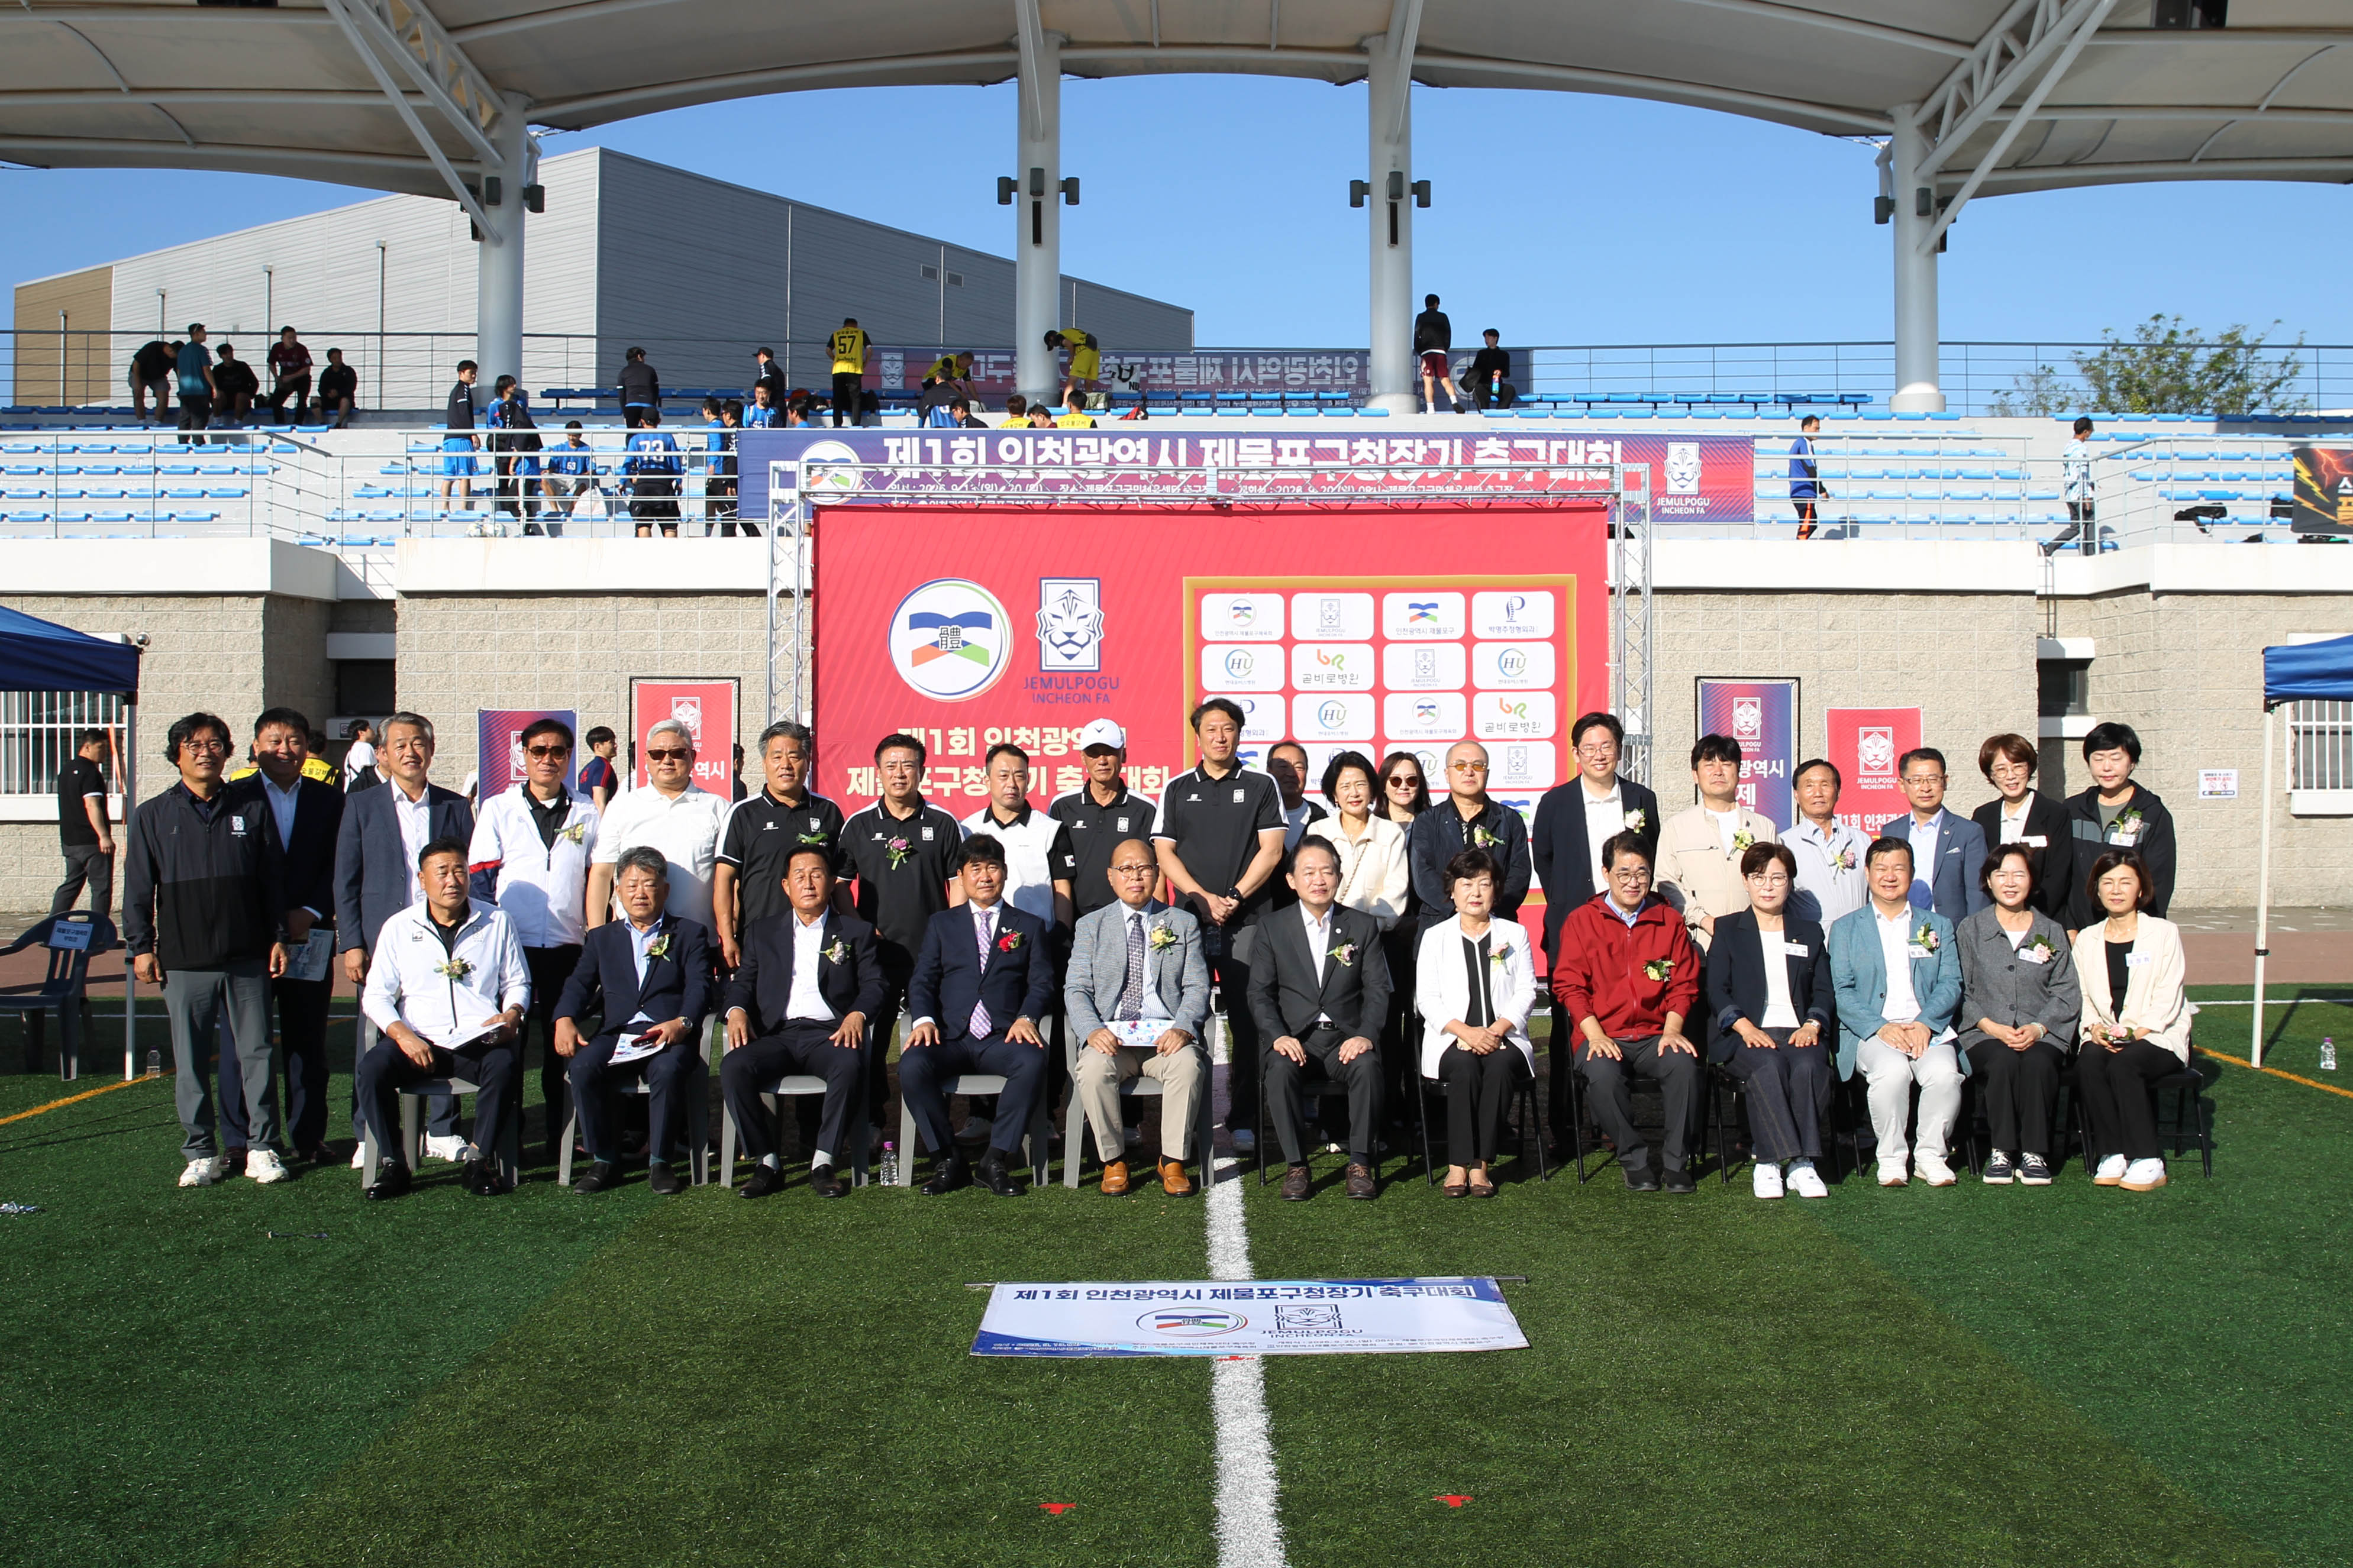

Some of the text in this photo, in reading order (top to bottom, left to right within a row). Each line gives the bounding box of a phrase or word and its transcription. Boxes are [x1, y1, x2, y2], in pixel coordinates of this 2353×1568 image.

[838, 335, 856, 354] 57
[638, 439, 664, 463] 73
[883, 436, 1622, 481] 제1회 인천광역시 제물포구청장기 축구대회
[1657, 497, 1710, 506] JEMULPOGU
[1230, 658, 1255, 670] HU
[1503, 657, 1527, 669] HU
[1023, 677, 1119, 690] JEMULPOGU
[1032, 693, 1111, 704] INCHEON FA
[1323, 709, 1347, 721] HU
[1014, 1285, 1473, 1301] 제1회 인천광역시 제물포구청장기 축구대회
